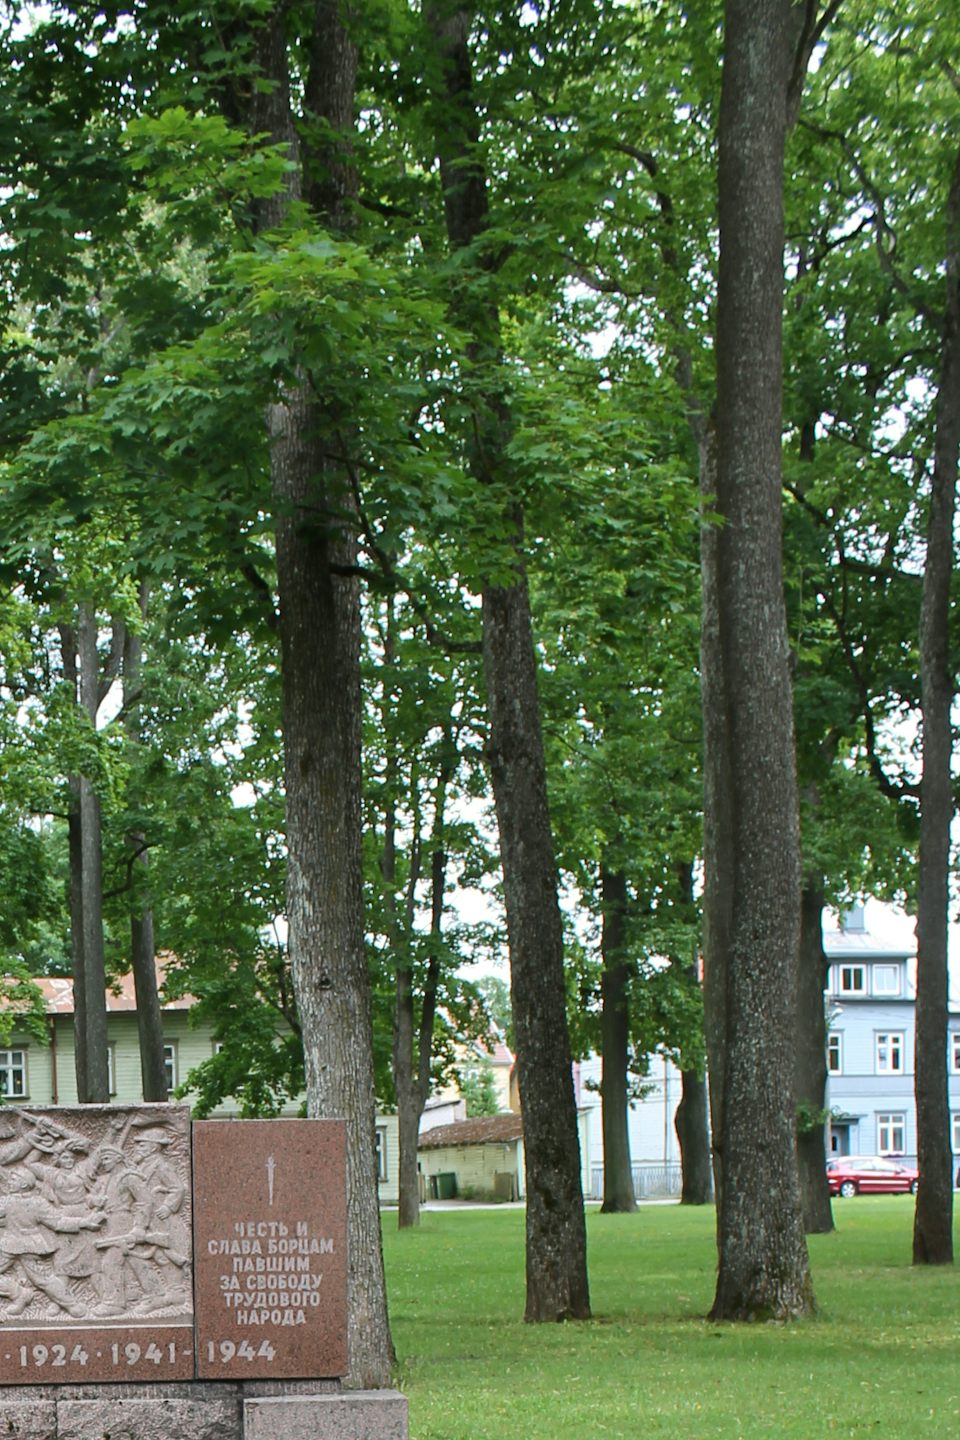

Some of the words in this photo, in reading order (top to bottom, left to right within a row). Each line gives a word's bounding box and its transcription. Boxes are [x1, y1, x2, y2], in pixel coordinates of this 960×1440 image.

[234, 1222, 288, 1237] ЧЕСТЬ
[297, 1222, 308, 1236] И
[208, 1239, 262, 1255] СЛАВА
[268, 1238, 334, 1254] БОРЦАМ
[233, 1257, 310, 1273] ПАВШИМ
[220, 1275, 240, 1290] ЗА
[247, 1274, 323, 1291] СВОБОДУ
[223, 1291, 320, 1308] ТРУДОВОГО
[237, 1309, 306, 1326] НАРОДА
[19, 1344, 89, 1367] 1924
[111, 1342, 177, 1365] 1941
[208, 1340, 276, 1363] 1944
